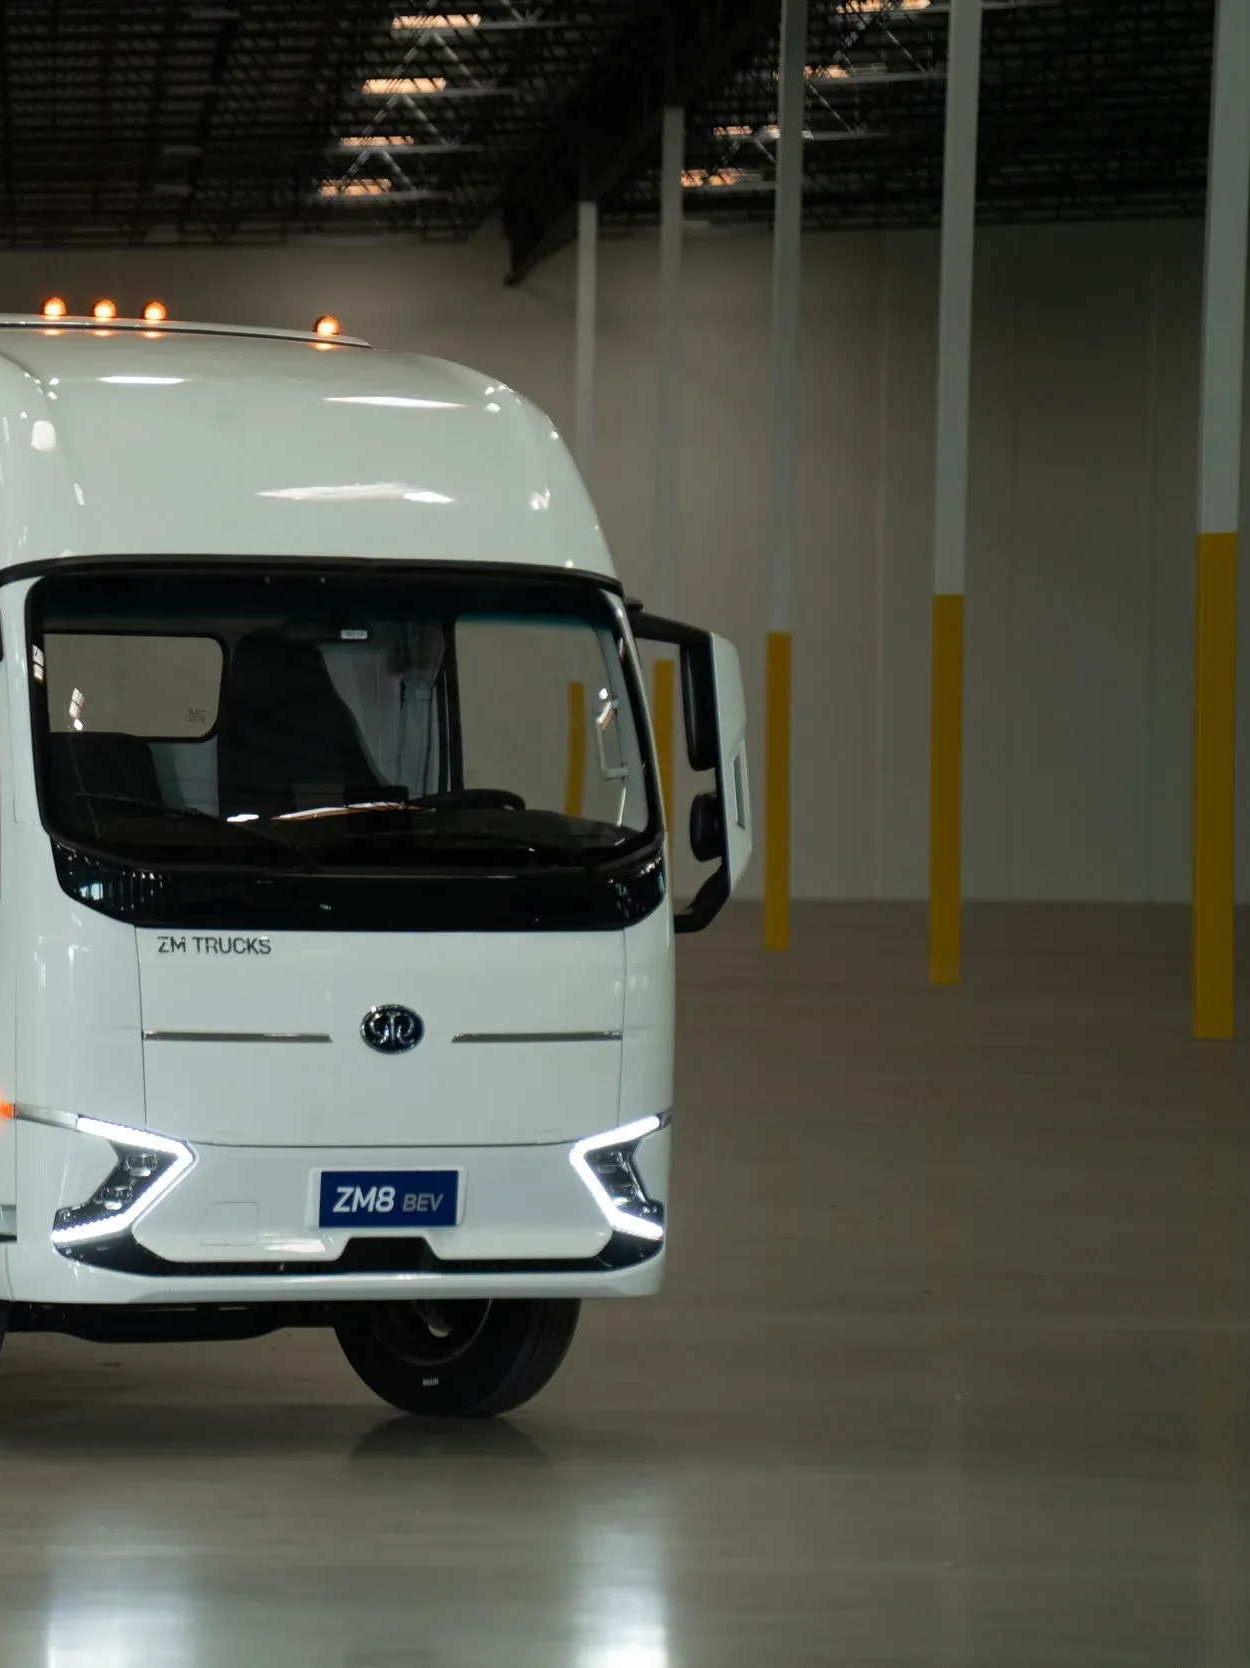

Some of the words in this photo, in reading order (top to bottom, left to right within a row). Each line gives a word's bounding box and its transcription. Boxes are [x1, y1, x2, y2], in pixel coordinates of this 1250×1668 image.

[157, 935, 187, 953] ZM
[191, 936, 272, 955] TRUCKS
[332, 1185, 396, 1213] ZM8
[402, 1193, 444, 1212] BEV
